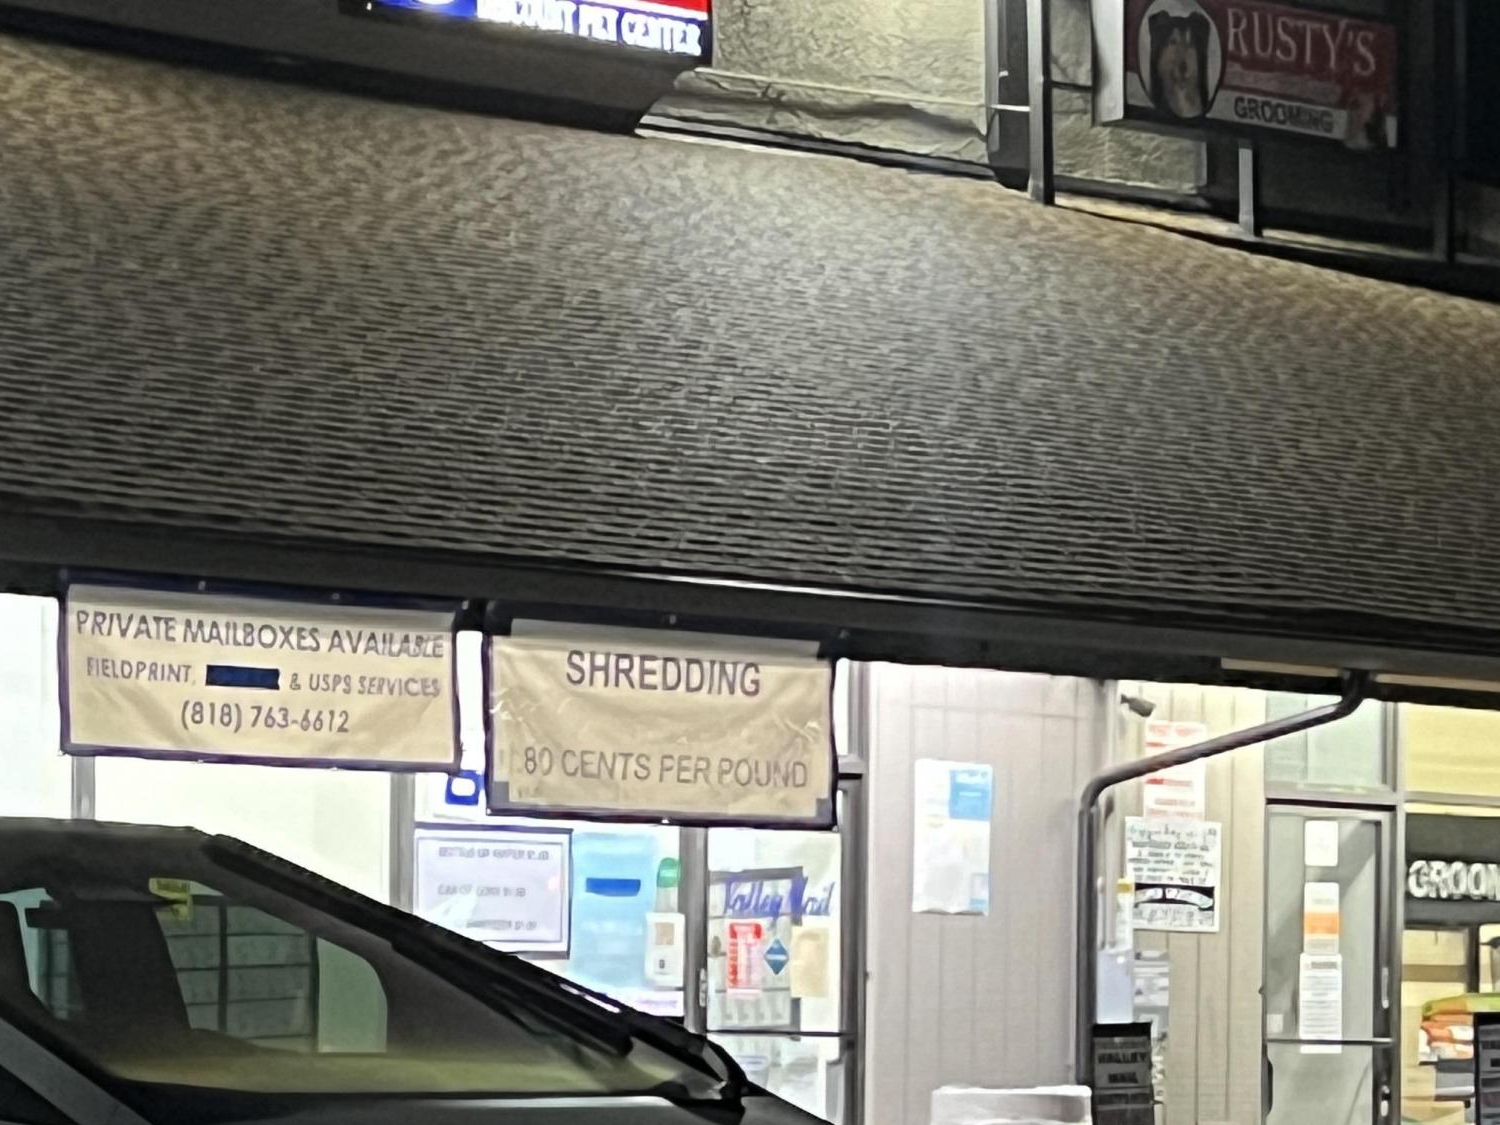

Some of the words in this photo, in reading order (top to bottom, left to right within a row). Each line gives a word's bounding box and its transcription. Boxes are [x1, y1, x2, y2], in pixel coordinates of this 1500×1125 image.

[578, 4, 619, 41] PET
[621, 12, 701, 56] CENTER
[1227, 7, 1377, 77] RUSTY'S
[1234, 95, 1334, 135] GROOMING
[76, 610, 176, 642] PRIVATE
[183, 618, 321, 652] MAILBOXES
[328, 630, 445, 658] AVAILABLE
[290, 673, 301, 691] &
[309, 673, 351, 694] USPS
[357, 676, 442, 698] SERVICES
[566, 649, 761, 697] SHREDDING
[181, 700, 242, 733] (818)
[250, 705, 350, 733] 763-6612
[524, 746, 553, 776] 80
[561, 749, 651, 780] CENTS
[658, 753, 710, 784] PER
[717, 757, 808, 788] POUND
